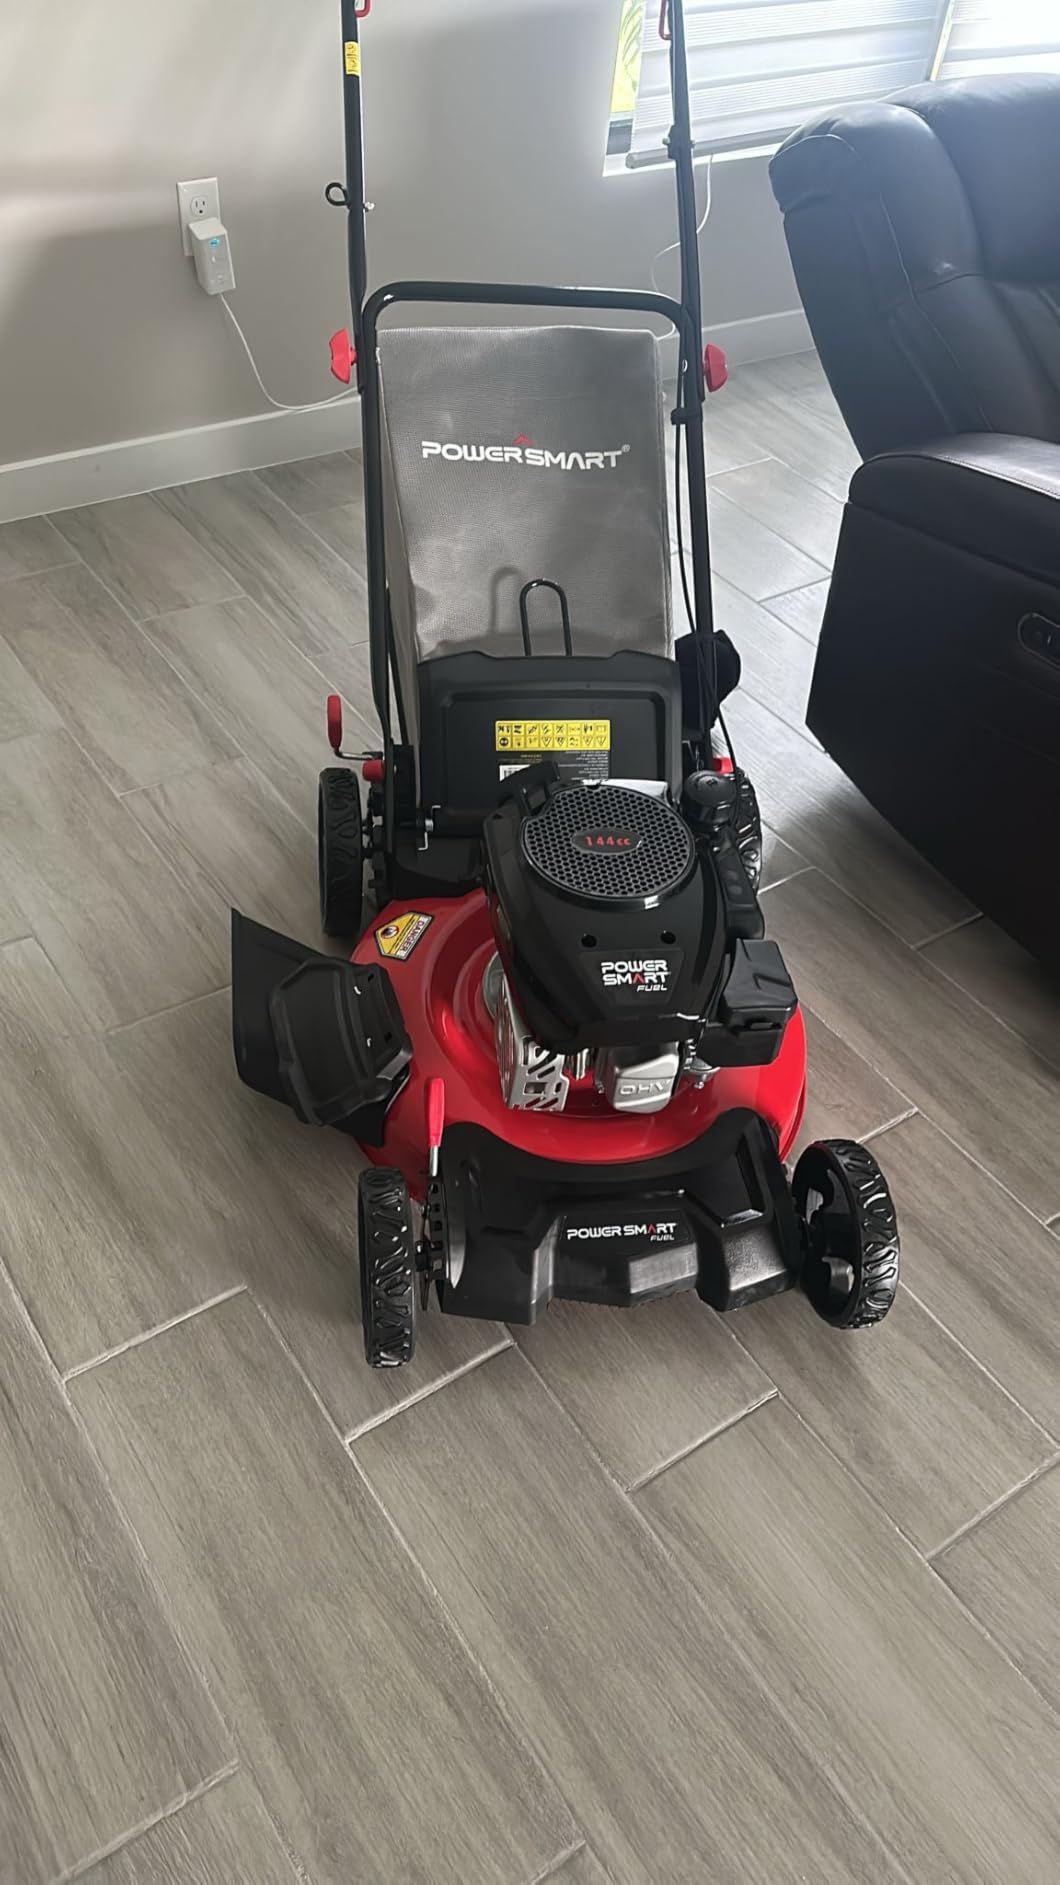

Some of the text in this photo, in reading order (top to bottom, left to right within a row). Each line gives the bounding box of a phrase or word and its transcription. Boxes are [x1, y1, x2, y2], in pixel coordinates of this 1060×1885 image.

[400, 920, 425, 951] DANGER
[601, 960, 668, 974] POWER
[603, 972, 669, 986] SMART
[637, 984, 668, 992] FUEL
[620, 1080, 671, 1095] OHV
[650, 1234, 675, 1242] FUEL
